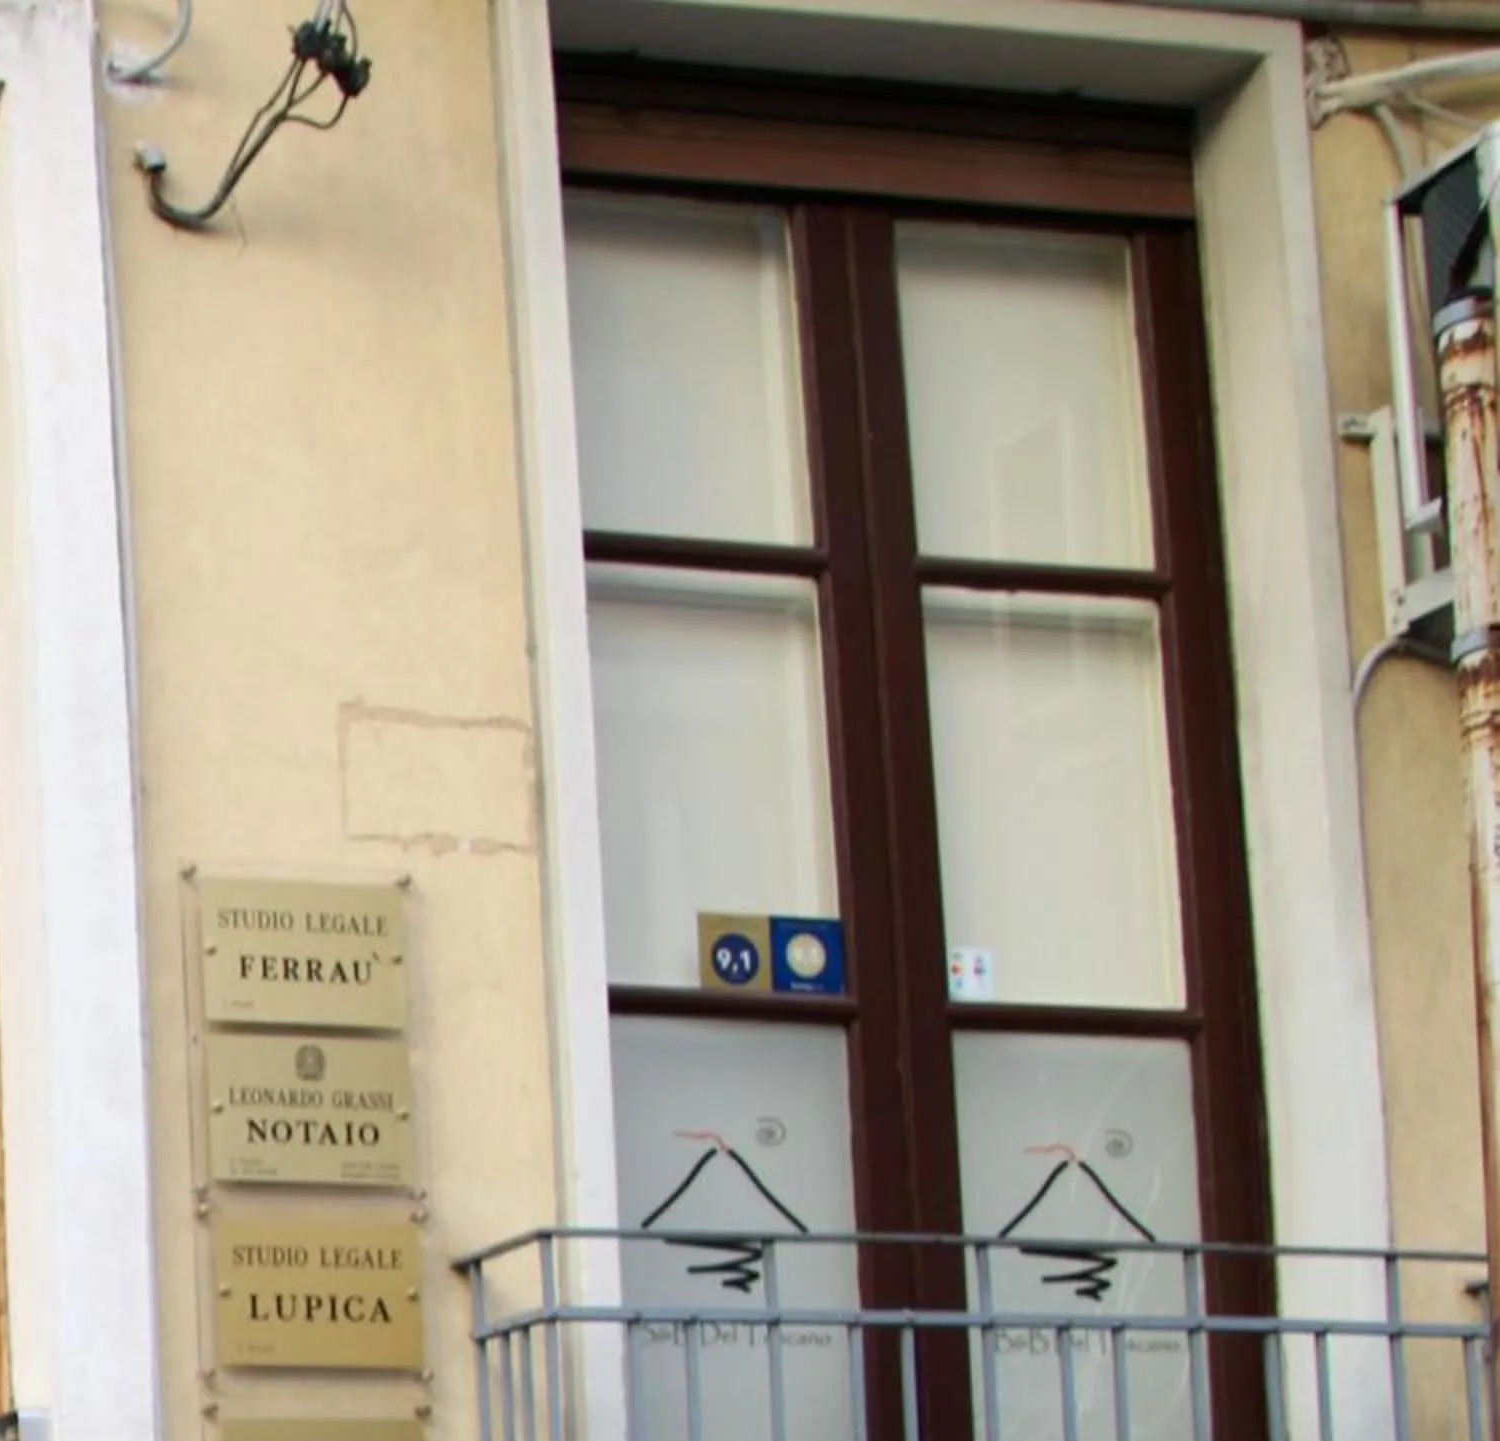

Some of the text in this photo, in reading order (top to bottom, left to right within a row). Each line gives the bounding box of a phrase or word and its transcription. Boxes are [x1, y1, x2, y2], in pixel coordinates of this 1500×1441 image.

[218, 908, 388, 937] STUDIO LEGALE
[716, 947, 751, 974] 9,1
[229, 1087, 393, 1112] LEONARDO GRASSI
[247, 1117, 380, 1147] NOTAIO
[232, 1246, 403, 1270] STUDIO LEGALE
[249, 1293, 393, 1324] LUPICA
